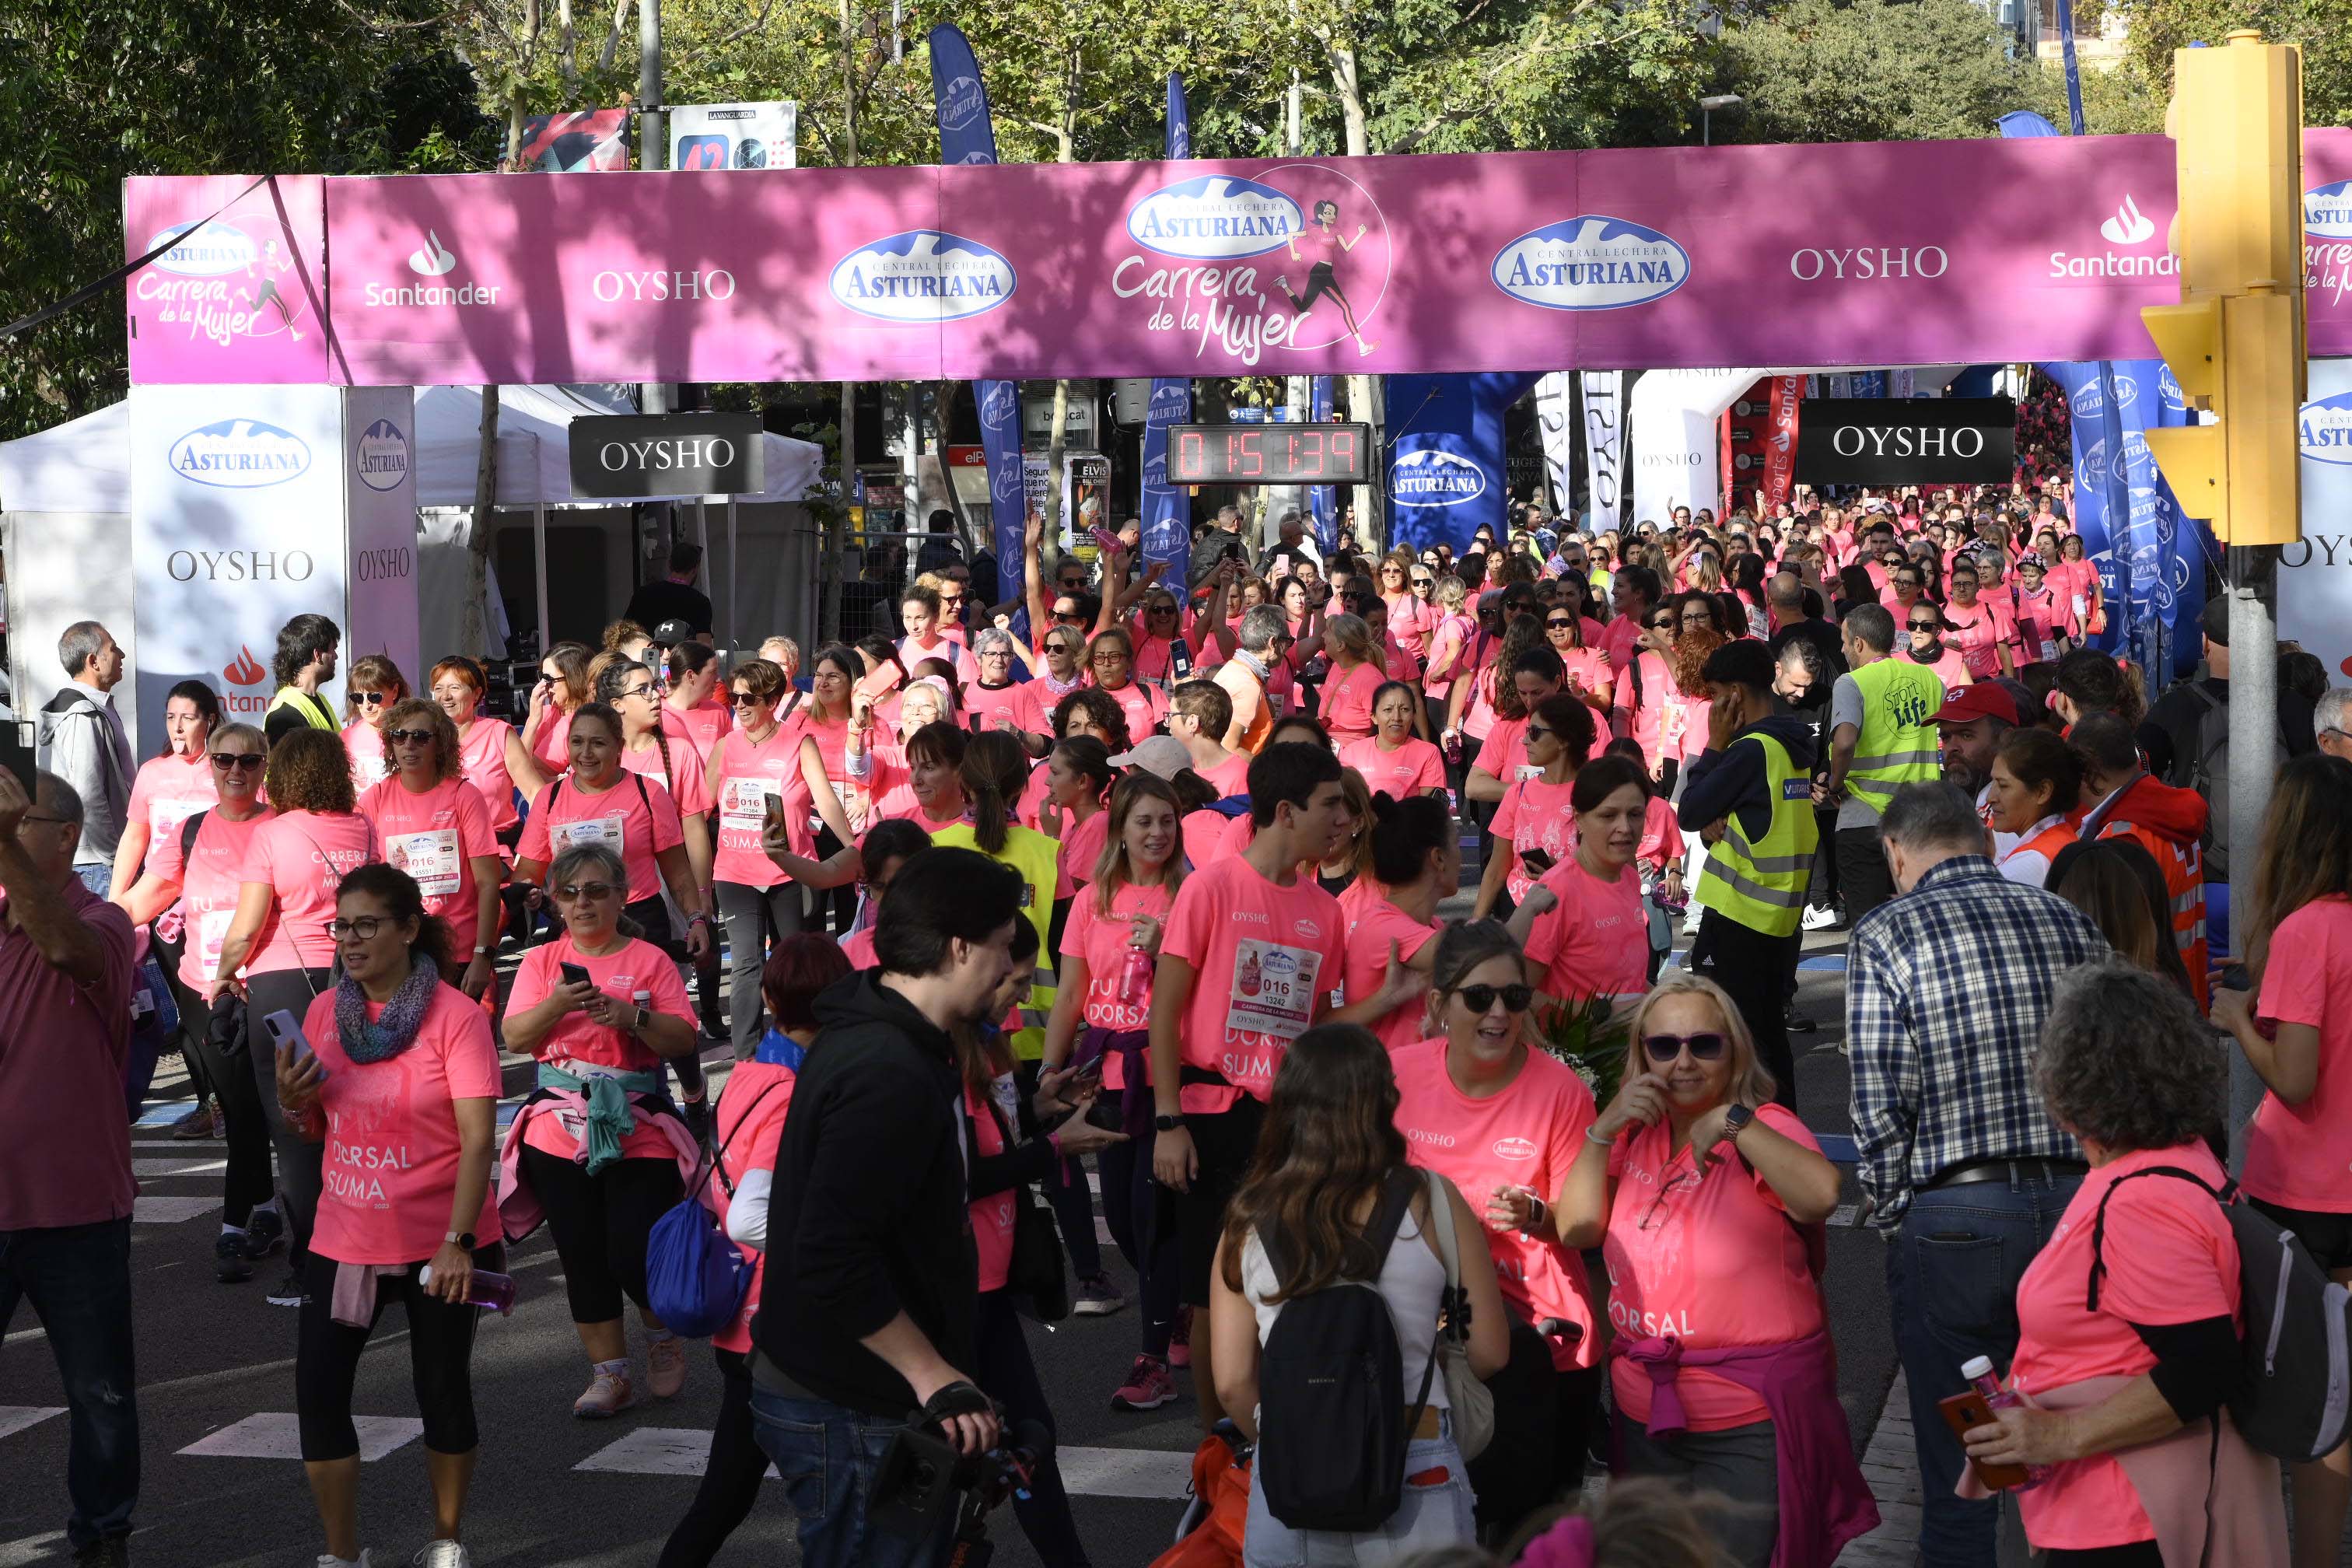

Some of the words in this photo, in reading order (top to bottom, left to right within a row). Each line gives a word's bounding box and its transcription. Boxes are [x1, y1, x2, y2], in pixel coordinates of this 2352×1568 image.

[716, 110, 755, 119] VANGUARDIA
[1229, 203, 1285, 212] LECHERA
[1140, 207, 1290, 238] ASTURIANA
[156, 241, 249, 261] ASTURIANA
[1538, 249, 1598, 259] CENTRAL
[1605, 247, 1668, 257] LECHERA
[845, 257, 1002, 290] ASTURIANA
[873, 261, 931, 271] CENTRAL
[937, 261, 996, 271] LECHERA
[1507, 252, 1675, 287] ASTURIANA
[1791, 246, 1948, 281] OYSHO
[136, 271, 228, 302] Carrera
[593, 270, 735, 302] OYSHO
[1112, 255, 1257, 299] Carrera
[365, 282, 500, 306] Santander
[159, 302, 176, 322] de
[180, 301, 191, 322] la
[190, 299, 261, 347] Mujer
[1148, 301, 1174, 331] de
[1181, 298, 1199, 331] la
[1196, 293, 1312, 366] Mujer
[1833, 425, 1983, 457] OYSHO
[180, 443, 301, 471] ASTURIANA
[360, 446, 405, 473] ASTURIANA
[600, 438, 735, 471] OYSHO
[1643, 452, 1702, 467] OYSHO
[1083, 466, 1107, 476] ELVIS
[1024, 480, 1041, 489] que
[1390, 475, 1478, 494] ASTURIANA
[1766, 455, 1787, 511] Sports
[166, 550, 313, 581] OYSHO
[359, 547, 410, 581] OYSHO
[1885, 681, 1920, 711] Sport
[1894, 696, 1927, 730] Life
[740, 798, 760, 807] 016
[722, 835, 762, 849] SUMA
[311, 849, 368, 863] CARRERA
[411, 856, 435, 867] 016
[190, 896, 212, 912] TU
[1232, 912, 1269, 925] OYSHO
[1595, 915, 1622, 929] OYSHO
[1295, 922, 1321, 936] ASTURIANA
[1264, 957, 1295, 971] ASTURIANA
[1263, 978, 1290, 995] 016
[1241, 1003, 1265, 1012] CARRERA
[1265, 996, 1286, 1007] 13242
[1090, 1005, 1150, 1026] DORSA
[1237, 1015, 1265, 1027] OYSHO
[1223, 1052, 1272, 1078] SUM
[1407, 1128, 1455, 1148] OYSHO
[1495, 1143, 1535, 1157] ASTURIANA
[327, 1170, 387, 1201] SUMA
